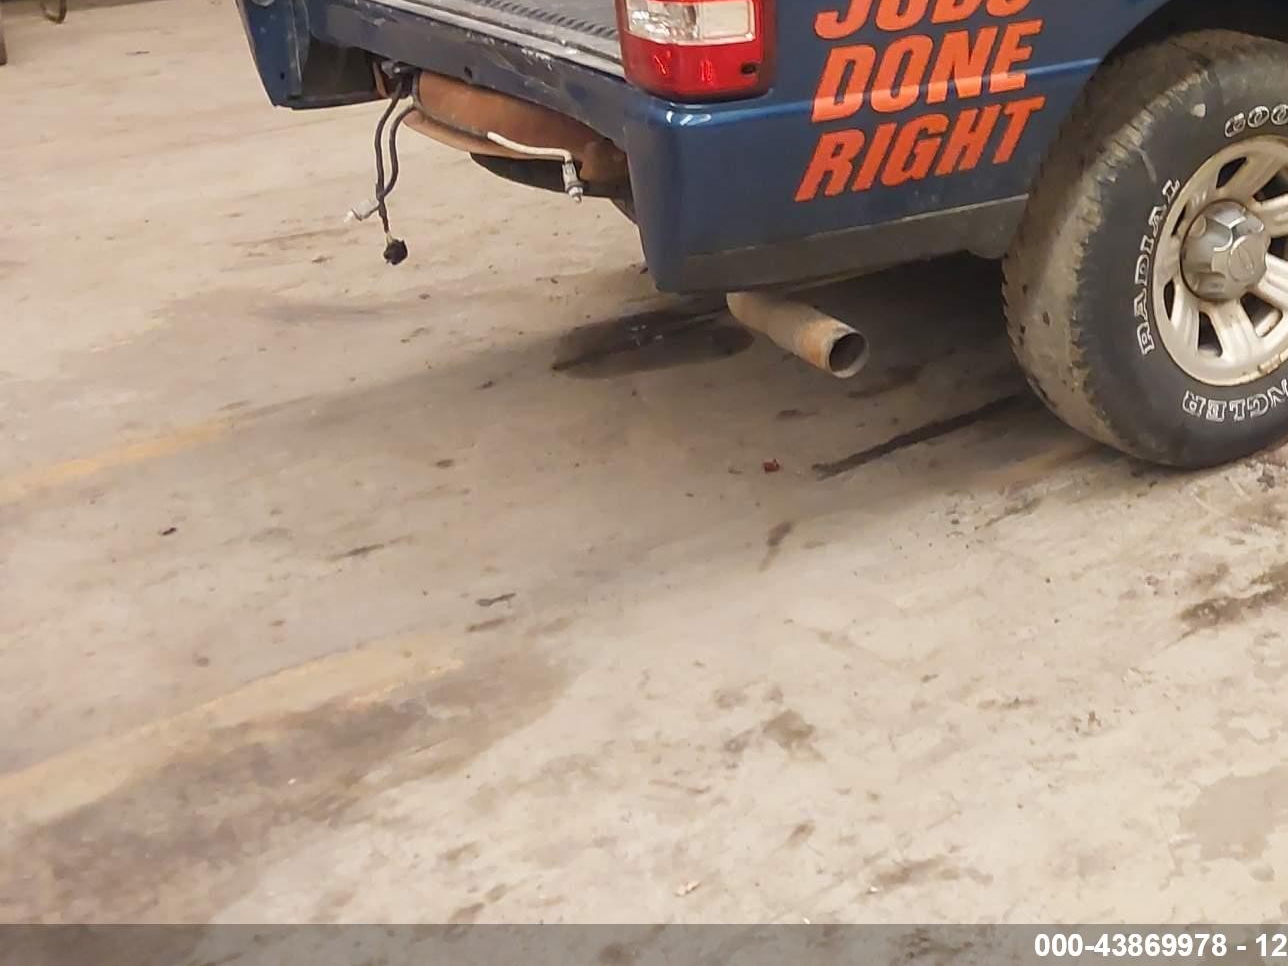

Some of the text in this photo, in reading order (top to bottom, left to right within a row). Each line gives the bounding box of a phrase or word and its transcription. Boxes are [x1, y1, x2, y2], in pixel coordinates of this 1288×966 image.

[811, 20, 1043, 123] DONE
[794, 97, 1046, 202] RIGHT
[1133, 179, 1181, 355] RADIAL
